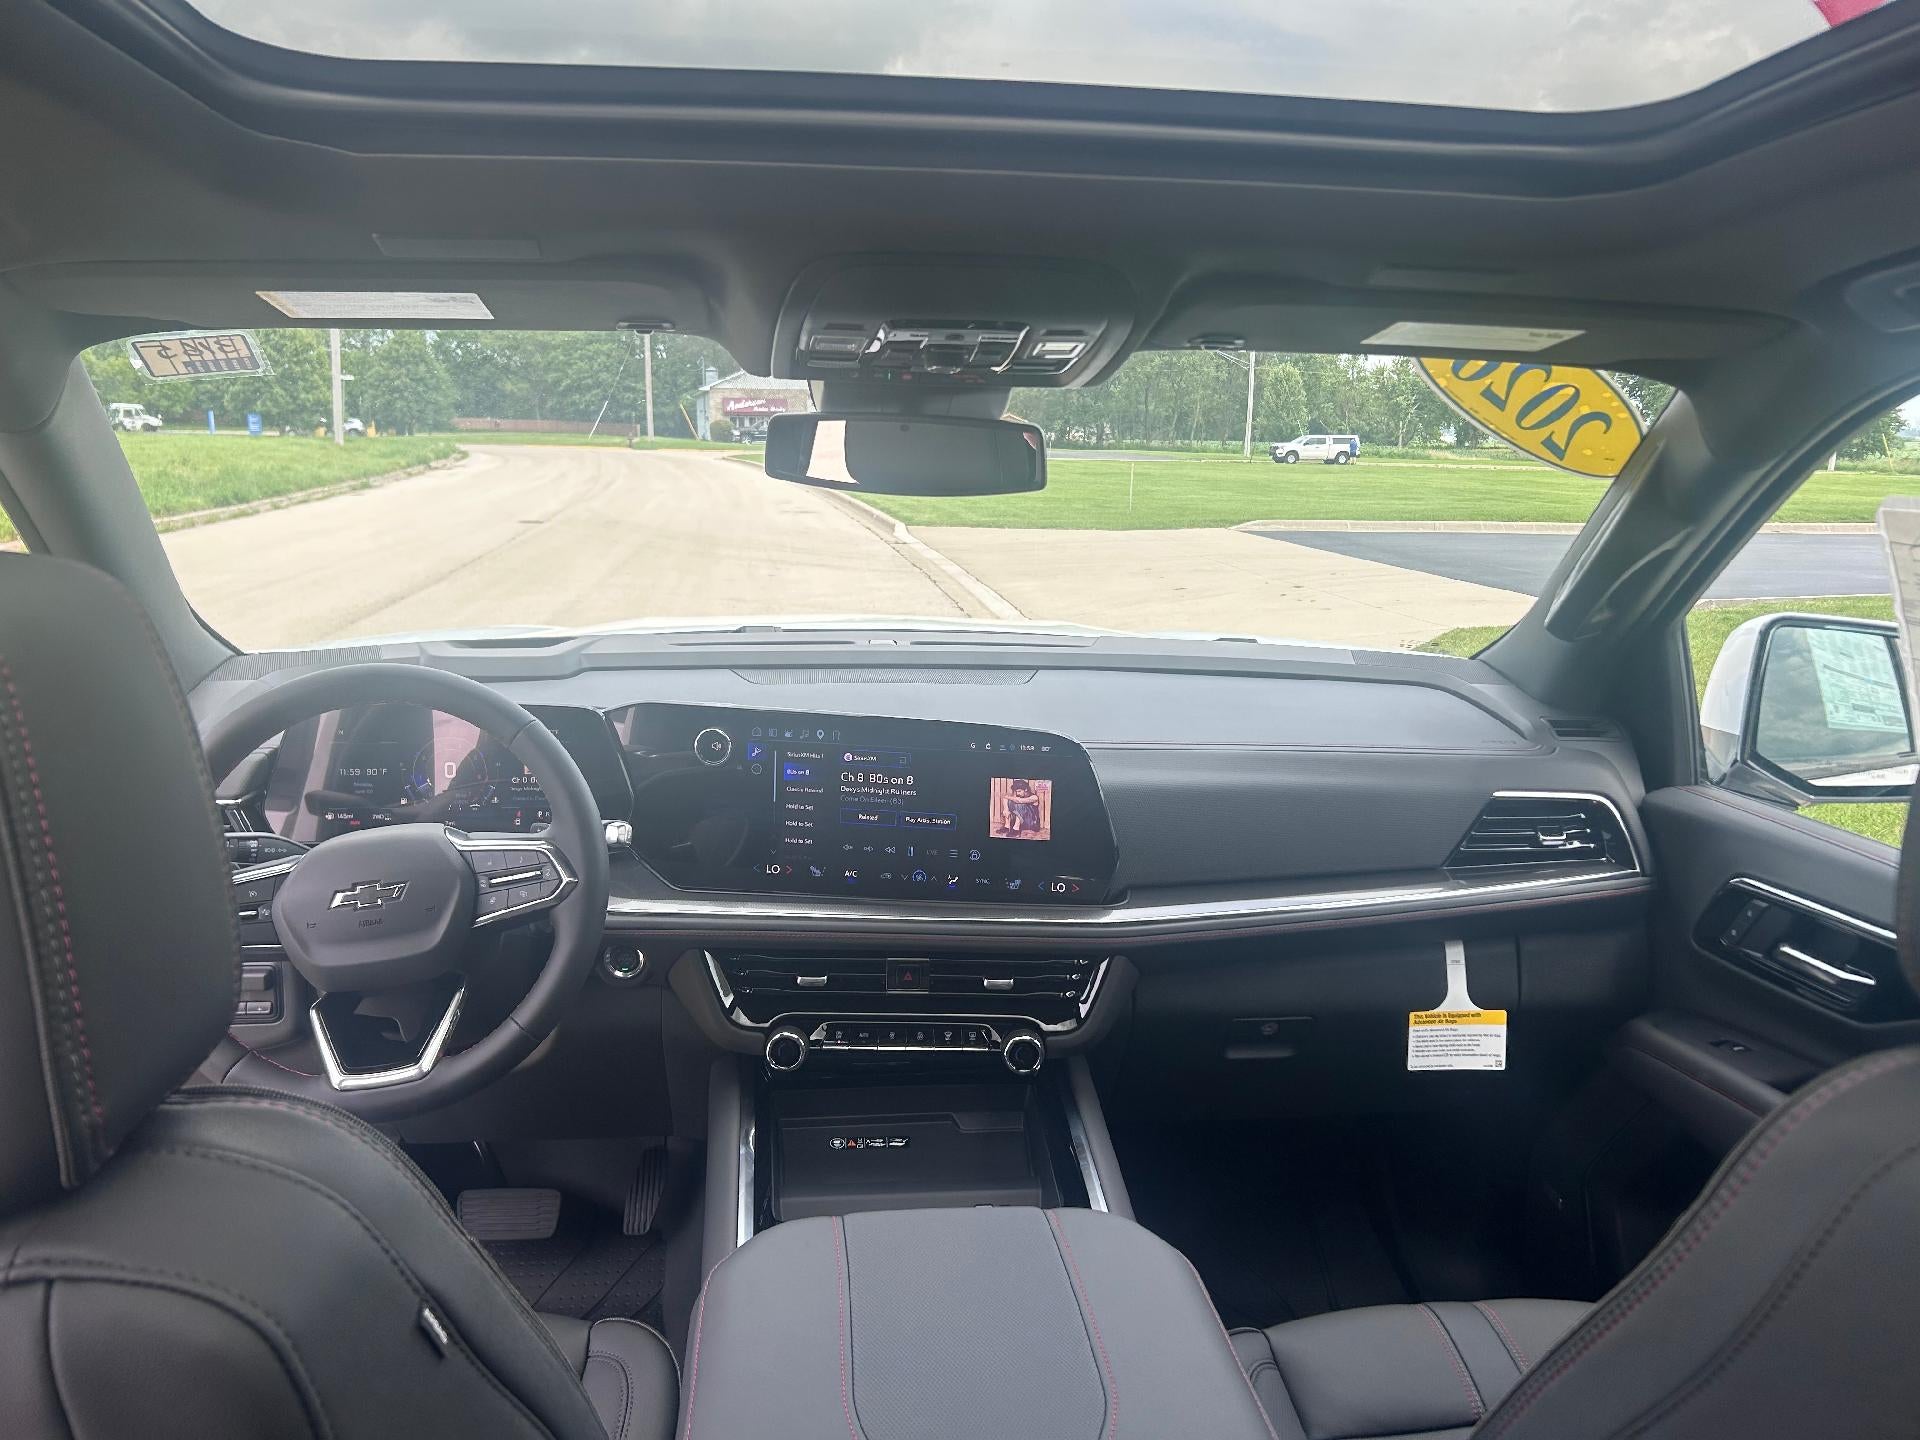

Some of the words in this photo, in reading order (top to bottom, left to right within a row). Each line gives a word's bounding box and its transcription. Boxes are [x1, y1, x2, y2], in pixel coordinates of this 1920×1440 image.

[339, 768, 361, 776] 11:59
[841, 771, 855, 782] Ch
[857, 772, 864, 783] 8
[869, 773, 889, 784] 80s
[890, 776, 904, 785] on
[906, 775, 914, 786] 8
[861, 786, 890, 796] Midnight
[890, 788, 917, 796] Runners
[766, 864, 781, 874] LO
[844, 870, 858, 878] A/C
[1051, 882, 1066, 893] LO
